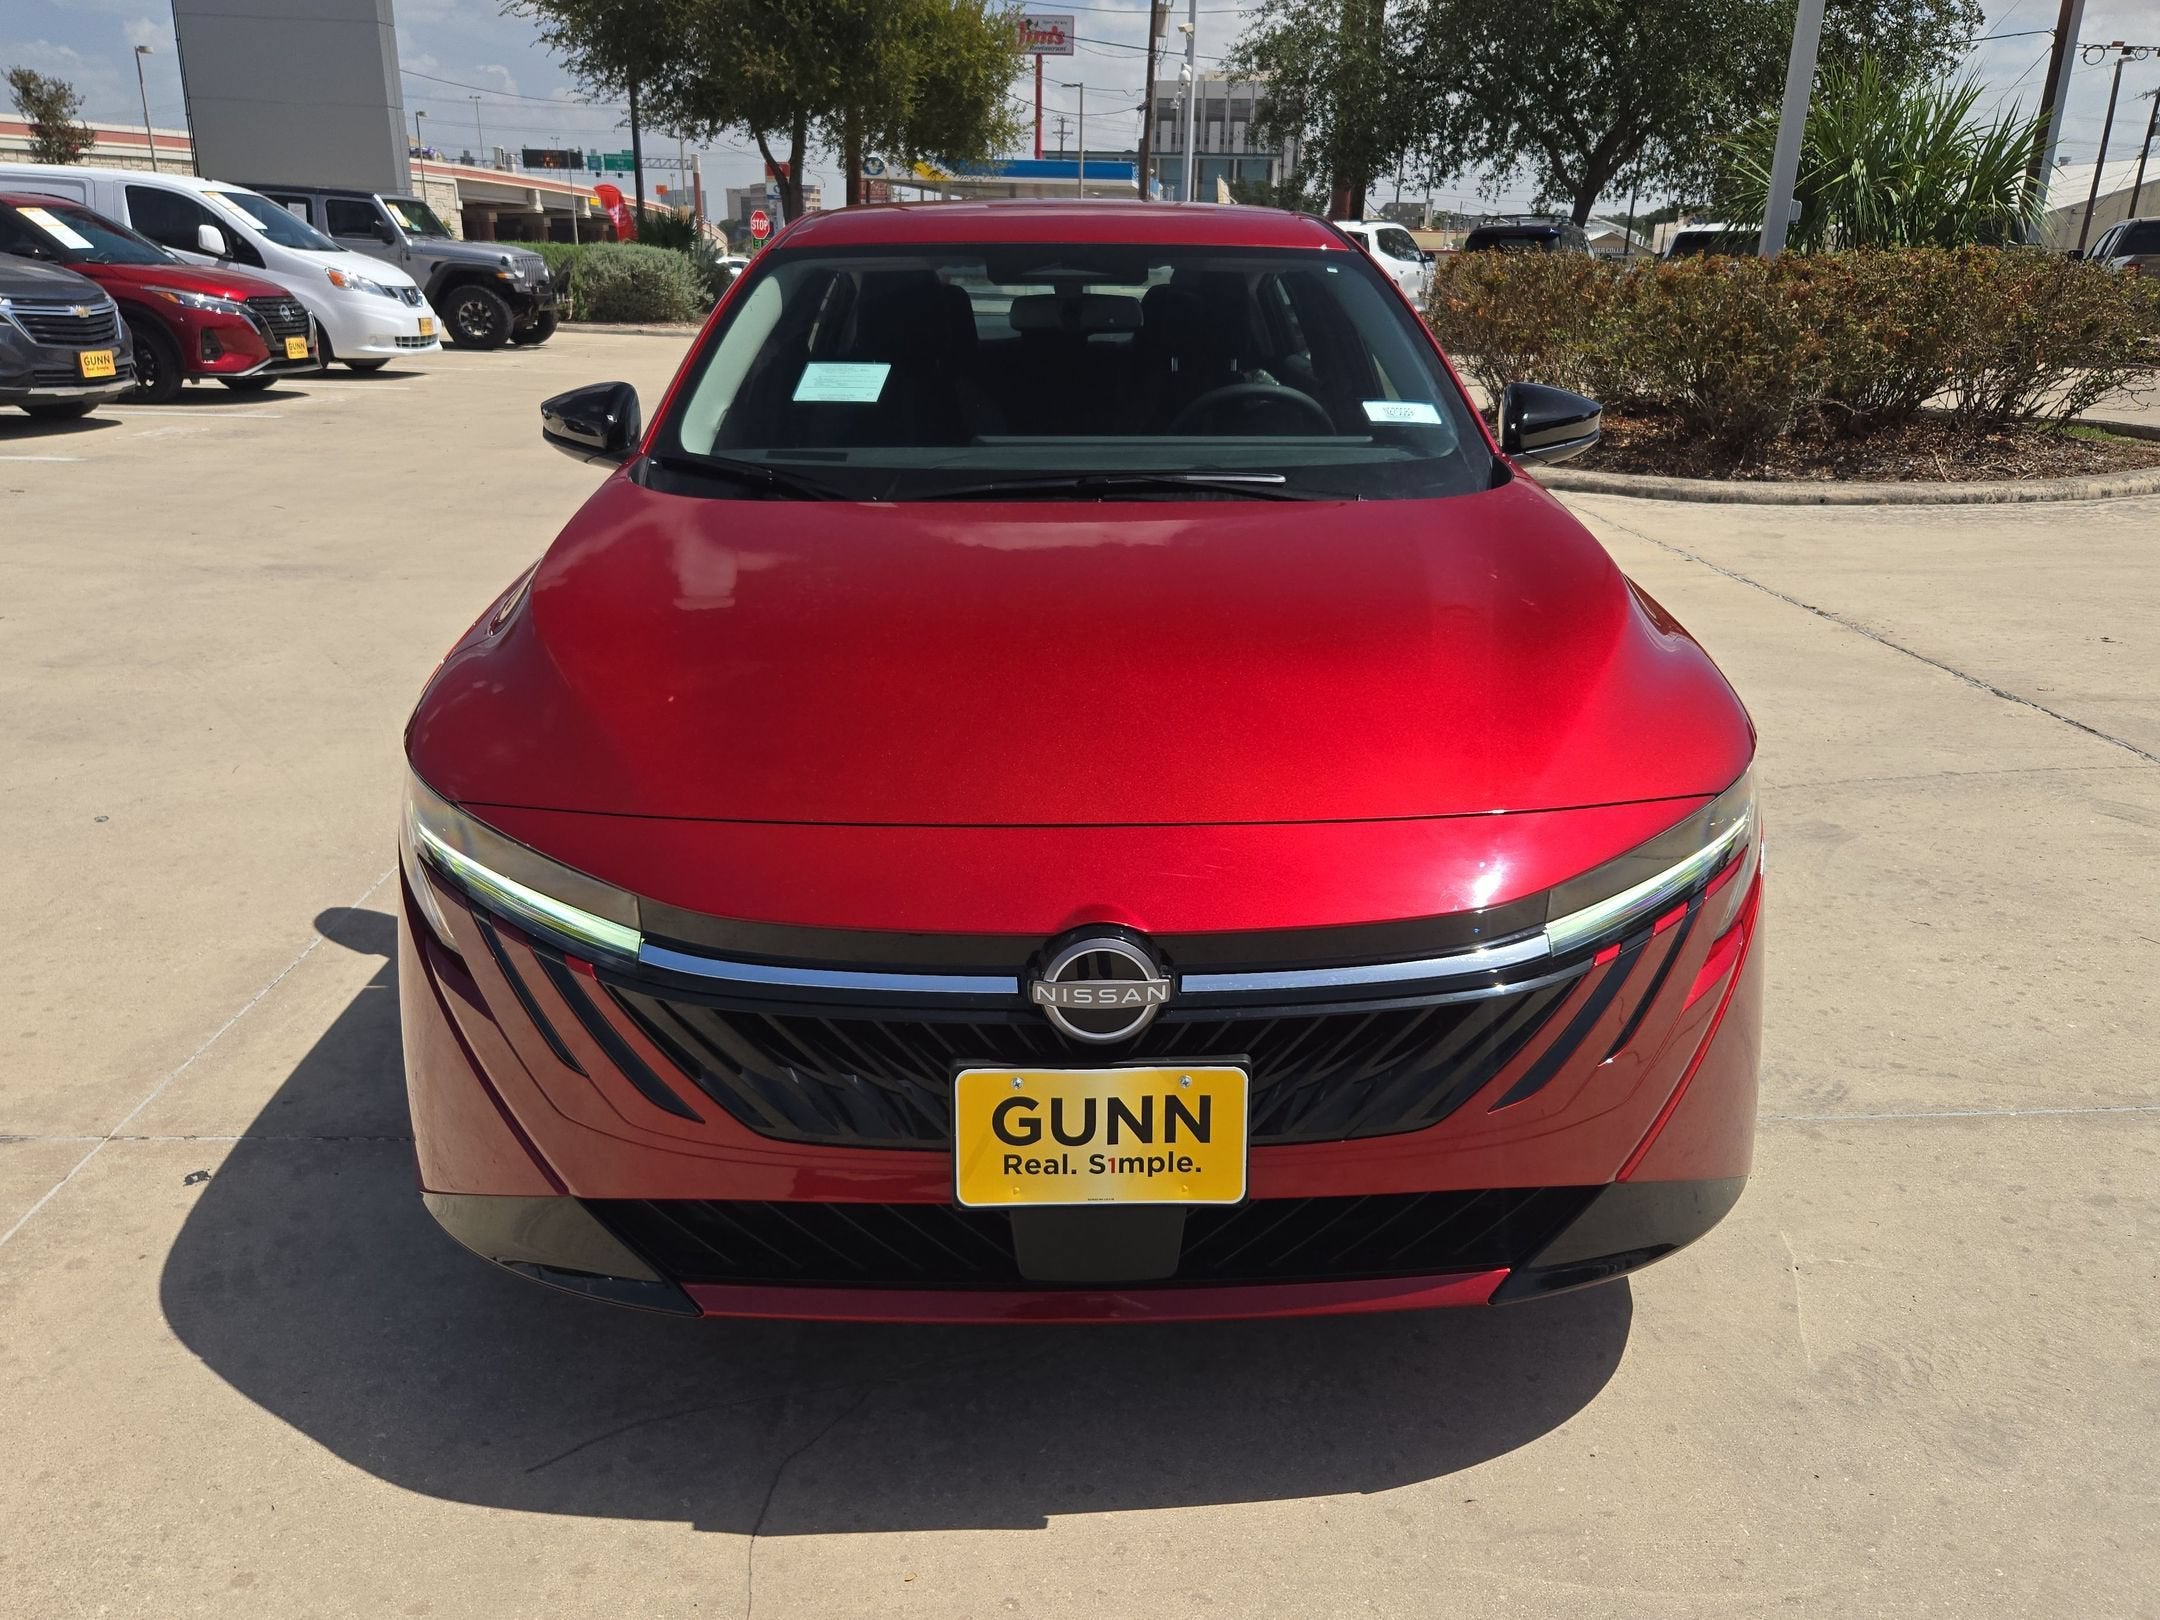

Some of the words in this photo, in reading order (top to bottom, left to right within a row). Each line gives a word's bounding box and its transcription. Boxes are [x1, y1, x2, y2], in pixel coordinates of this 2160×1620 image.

[1018, 21, 1065, 46] Jim's
[751, 220, 768, 230] STOP
[84, 355, 110, 366] GUNN
[1036, 984, 1166, 1004] NISSAN
[992, 1095, 1211, 1147] GUNN
[1003, 1153, 1077, 1175] Real.
